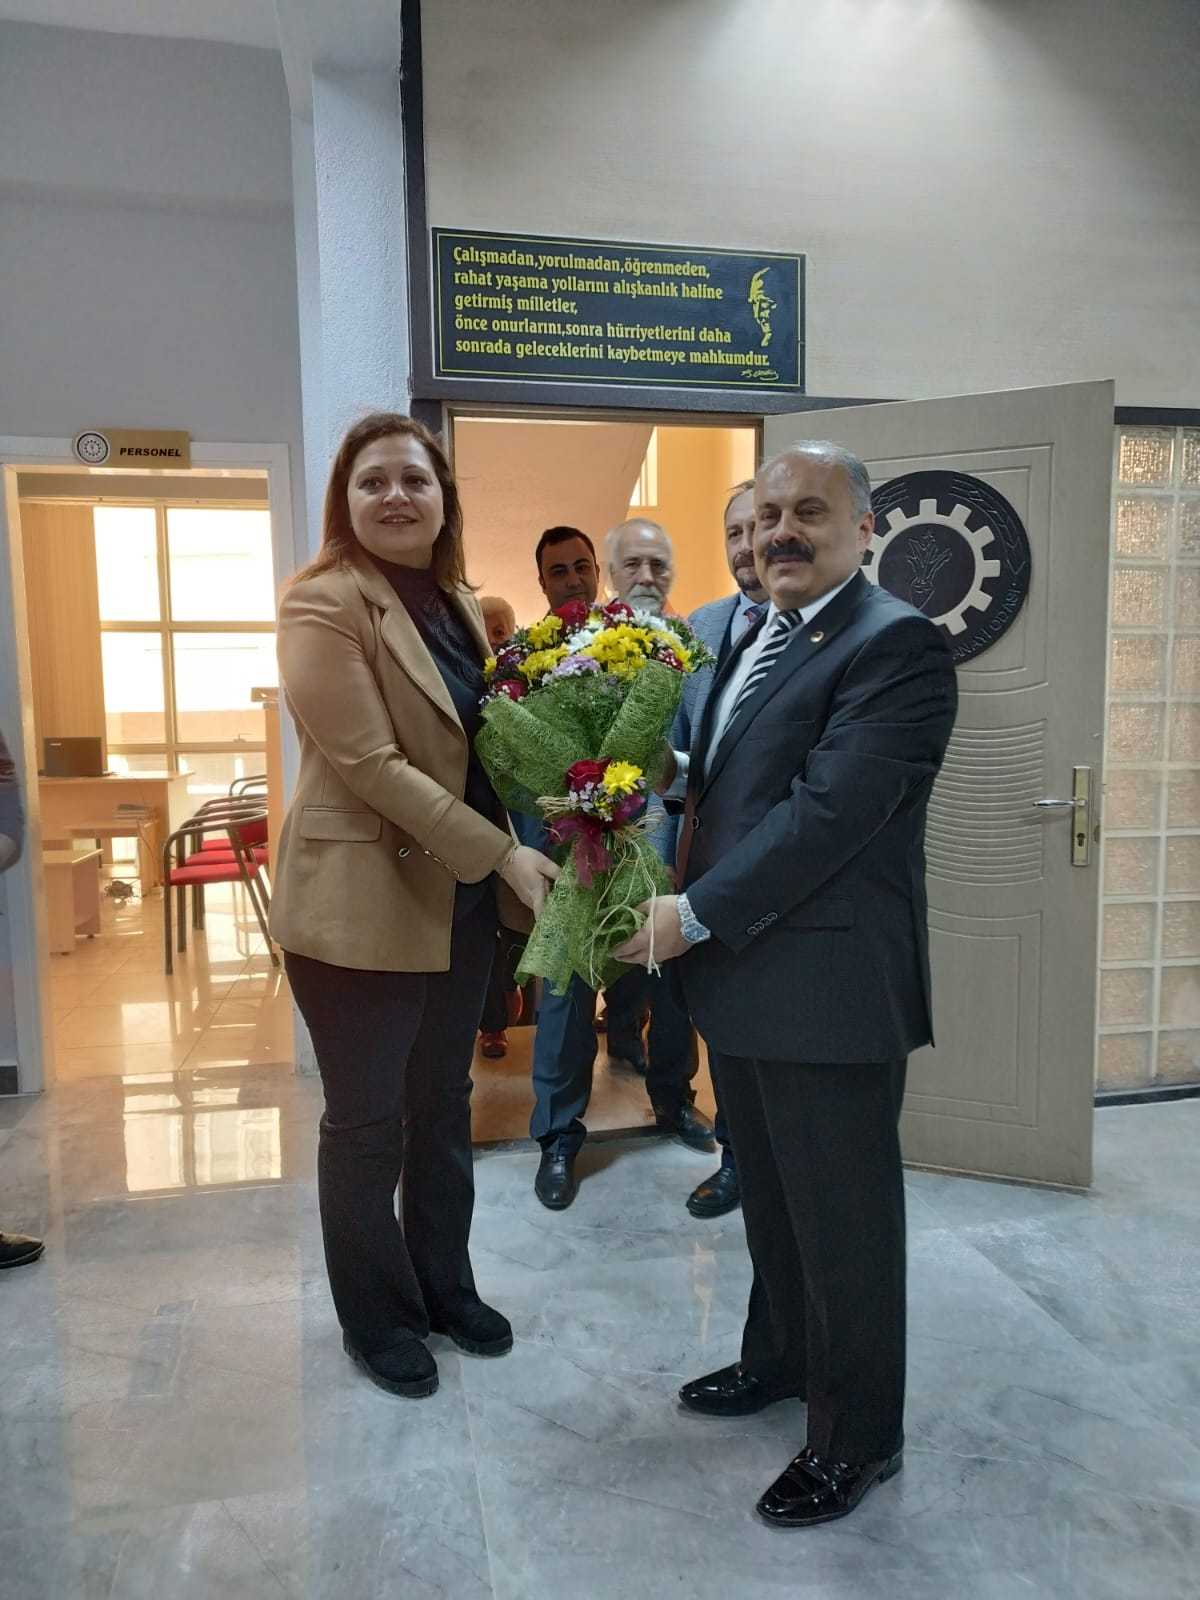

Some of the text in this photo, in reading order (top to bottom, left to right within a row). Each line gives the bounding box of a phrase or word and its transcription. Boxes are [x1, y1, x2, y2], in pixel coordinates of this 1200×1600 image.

[454, 269, 723, 299] rahat yaşama yollarını alışkanlık haline
[454, 293, 578, 315] getirmiş milletler,
[455, 314, 488, 330] önce
[606, 322, 695, 342] hürriyetlerini
[699, 327, 732, 343] daha
[455, 339, 770, 366] sonrada geleceklerini kaybetmeye mahkumdur.
[119, 447, 182, 457] PERSONEL
